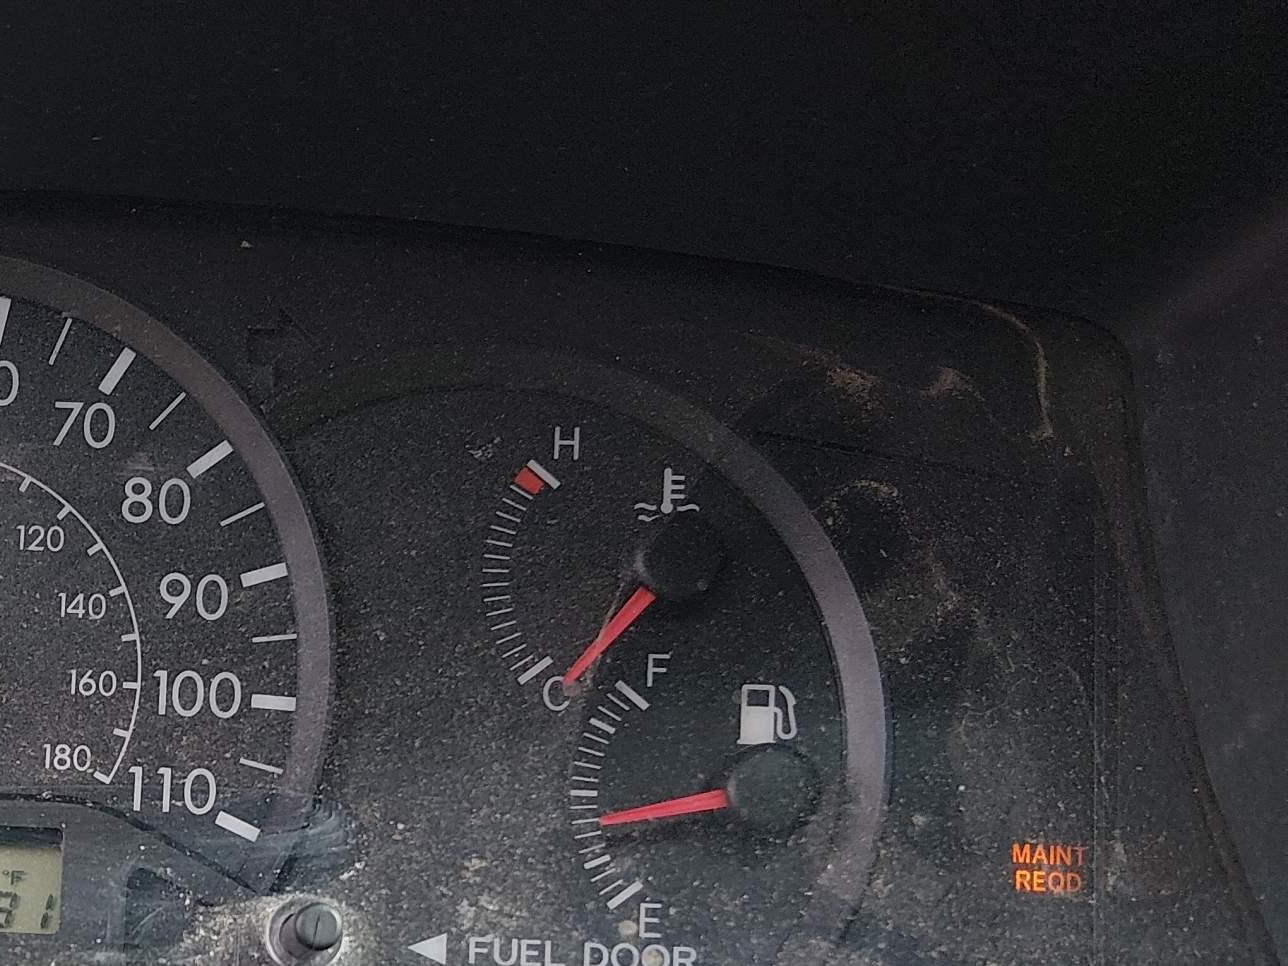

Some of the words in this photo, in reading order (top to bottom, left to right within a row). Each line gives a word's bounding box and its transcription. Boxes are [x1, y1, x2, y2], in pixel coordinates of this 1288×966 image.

[53, 401, 116, 449] 70
[553, 426, 580, 460] H
[121, 475, 191, 525] 80
[16, 525, 65, 553] 120
[58, 592, 106, 620] 140
[159, 572, 230, 621] 90
[70, 669, 117, 697] 160
[646, 653, 671, 687] F
[155, 670, 242, 719] 100
[43, 743, 92, 772] 180
[128, 766, 218, 816] 110
[1011, 842, 1089, 866] MAINT
[1015, 870, 1082, 893] REQD
[638, 902, 663, 939] E
